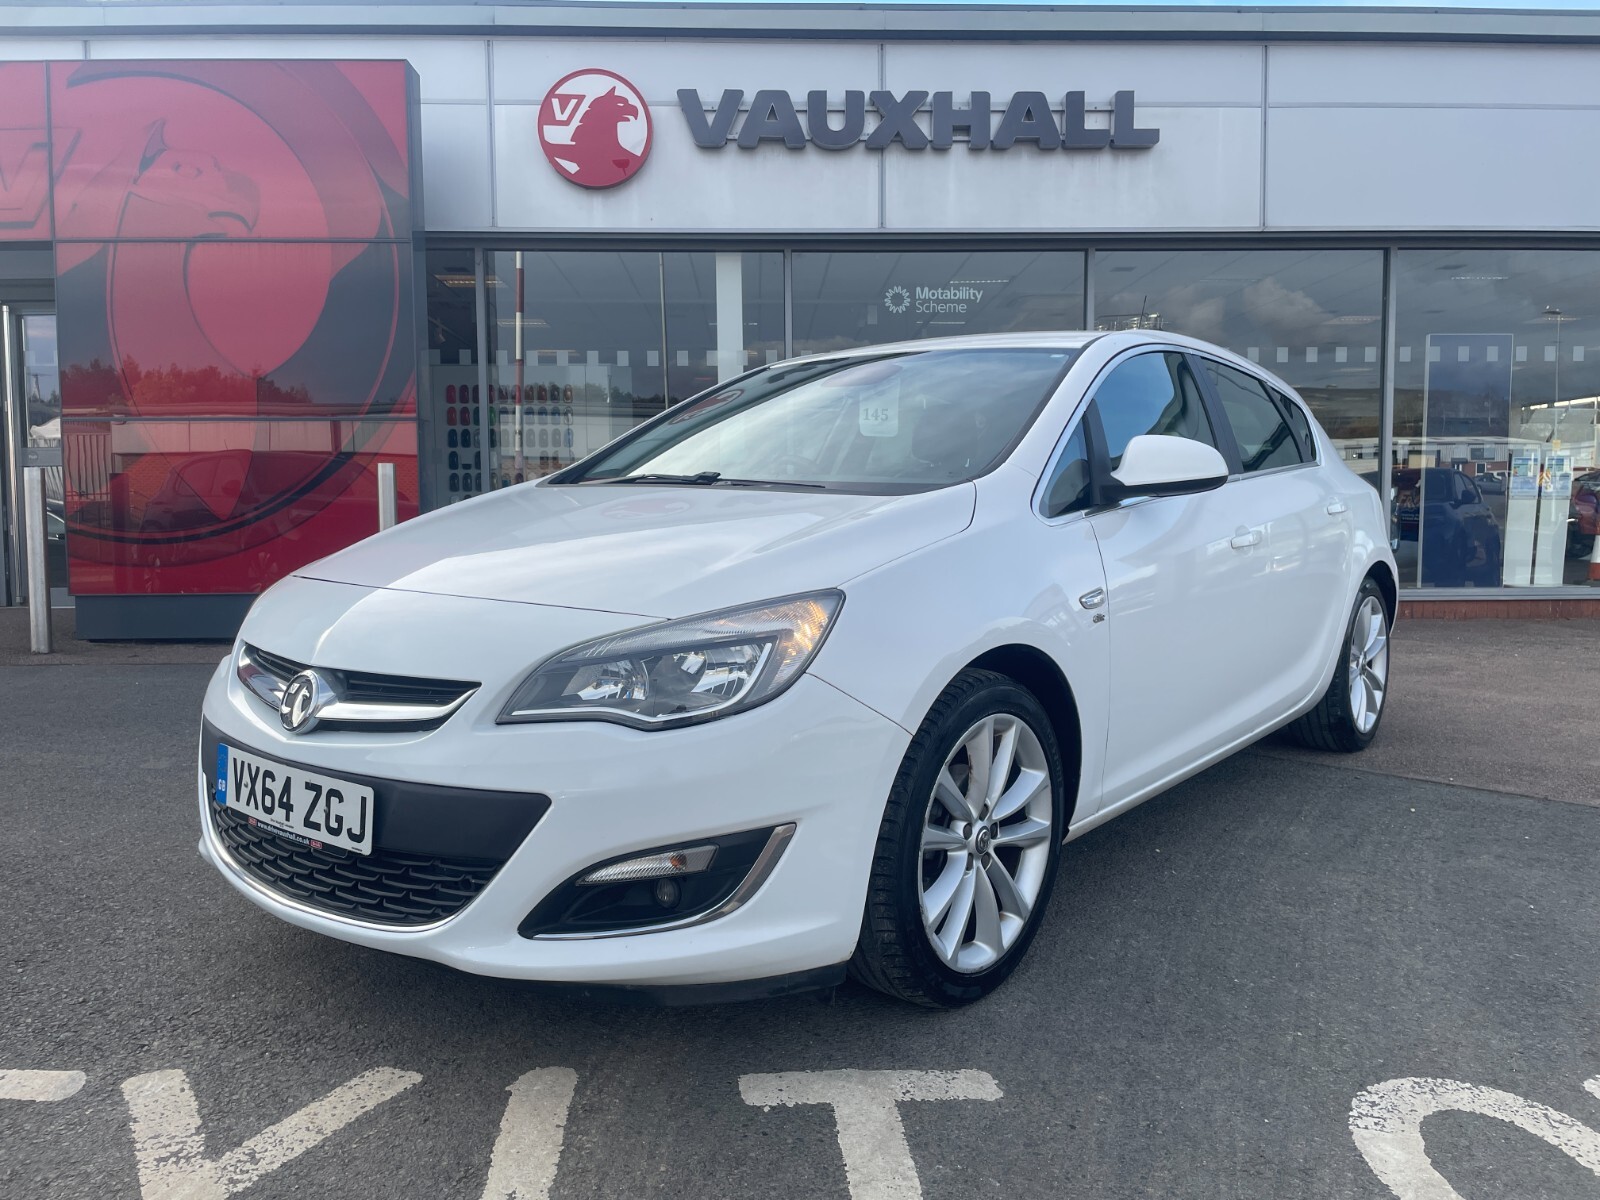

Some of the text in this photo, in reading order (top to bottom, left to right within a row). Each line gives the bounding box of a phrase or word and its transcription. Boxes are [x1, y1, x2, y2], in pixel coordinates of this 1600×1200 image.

[677, 89, 1160, 150] VAUXHALL
[915, 287, 984, 303] Motability
[915, 300, 967, 313] Scheme
[863, 407, 889, 421] 145
[233, 757, 367, 844] VX64 ZGJ
